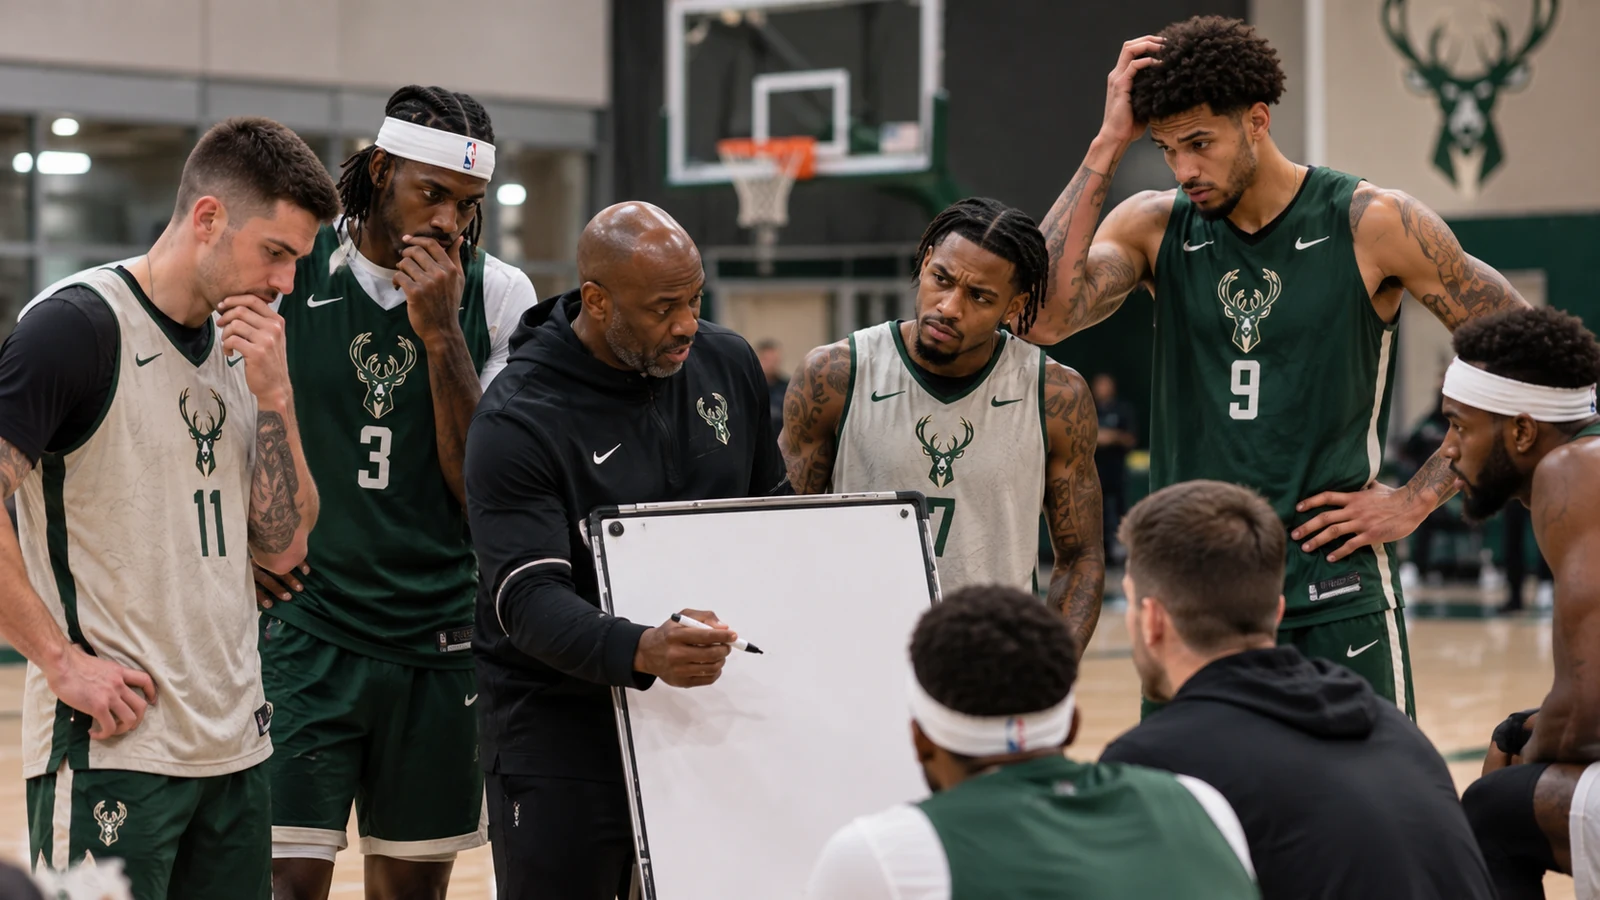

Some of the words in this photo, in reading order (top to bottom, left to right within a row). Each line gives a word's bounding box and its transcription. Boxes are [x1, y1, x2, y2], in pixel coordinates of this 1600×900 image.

[1229, 360, 1260, 420] 9
[358, 425, 392, 490] 3
[194, 489, 226, 557] 11
[926, 497, 955, 557] 7
